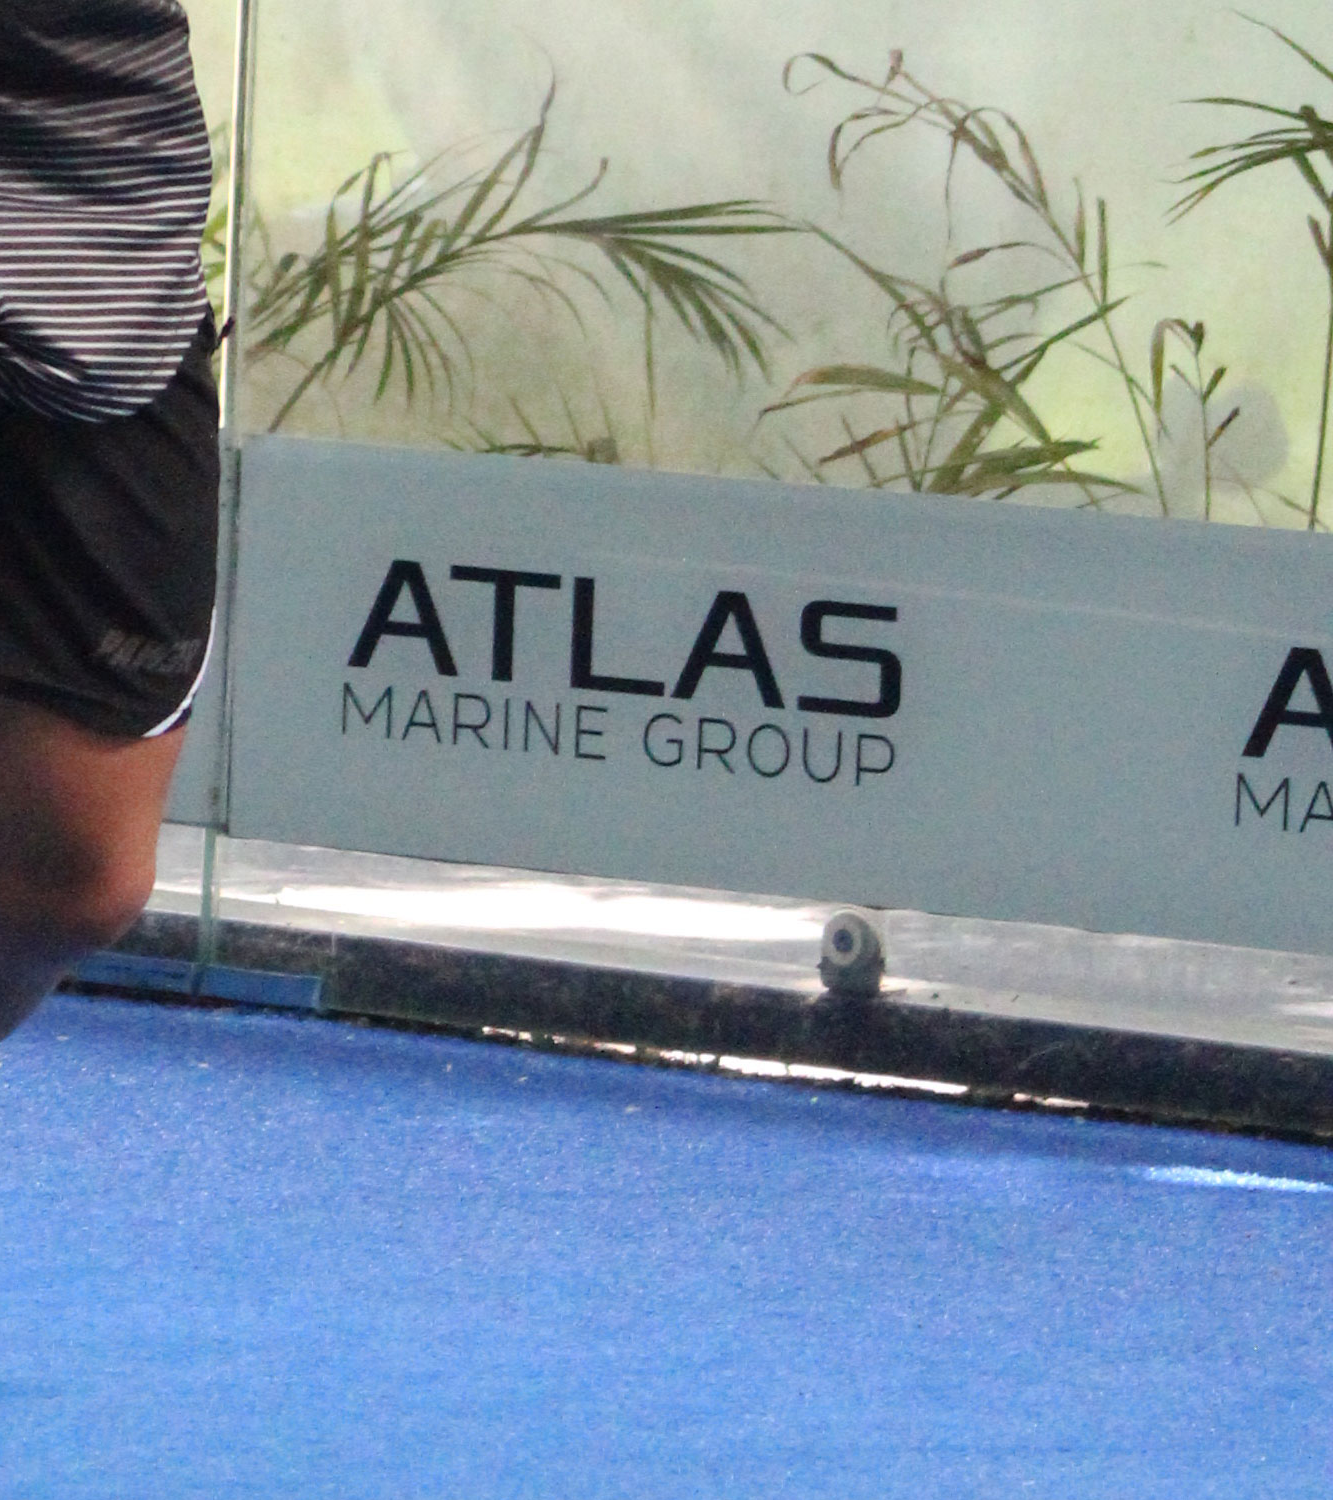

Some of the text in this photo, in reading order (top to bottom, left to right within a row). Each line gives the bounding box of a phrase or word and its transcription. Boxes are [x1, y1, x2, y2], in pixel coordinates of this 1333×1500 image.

[346, 559, 903, 718] ATLAS
[341, 682, 896, 787] MARINE GROUP
